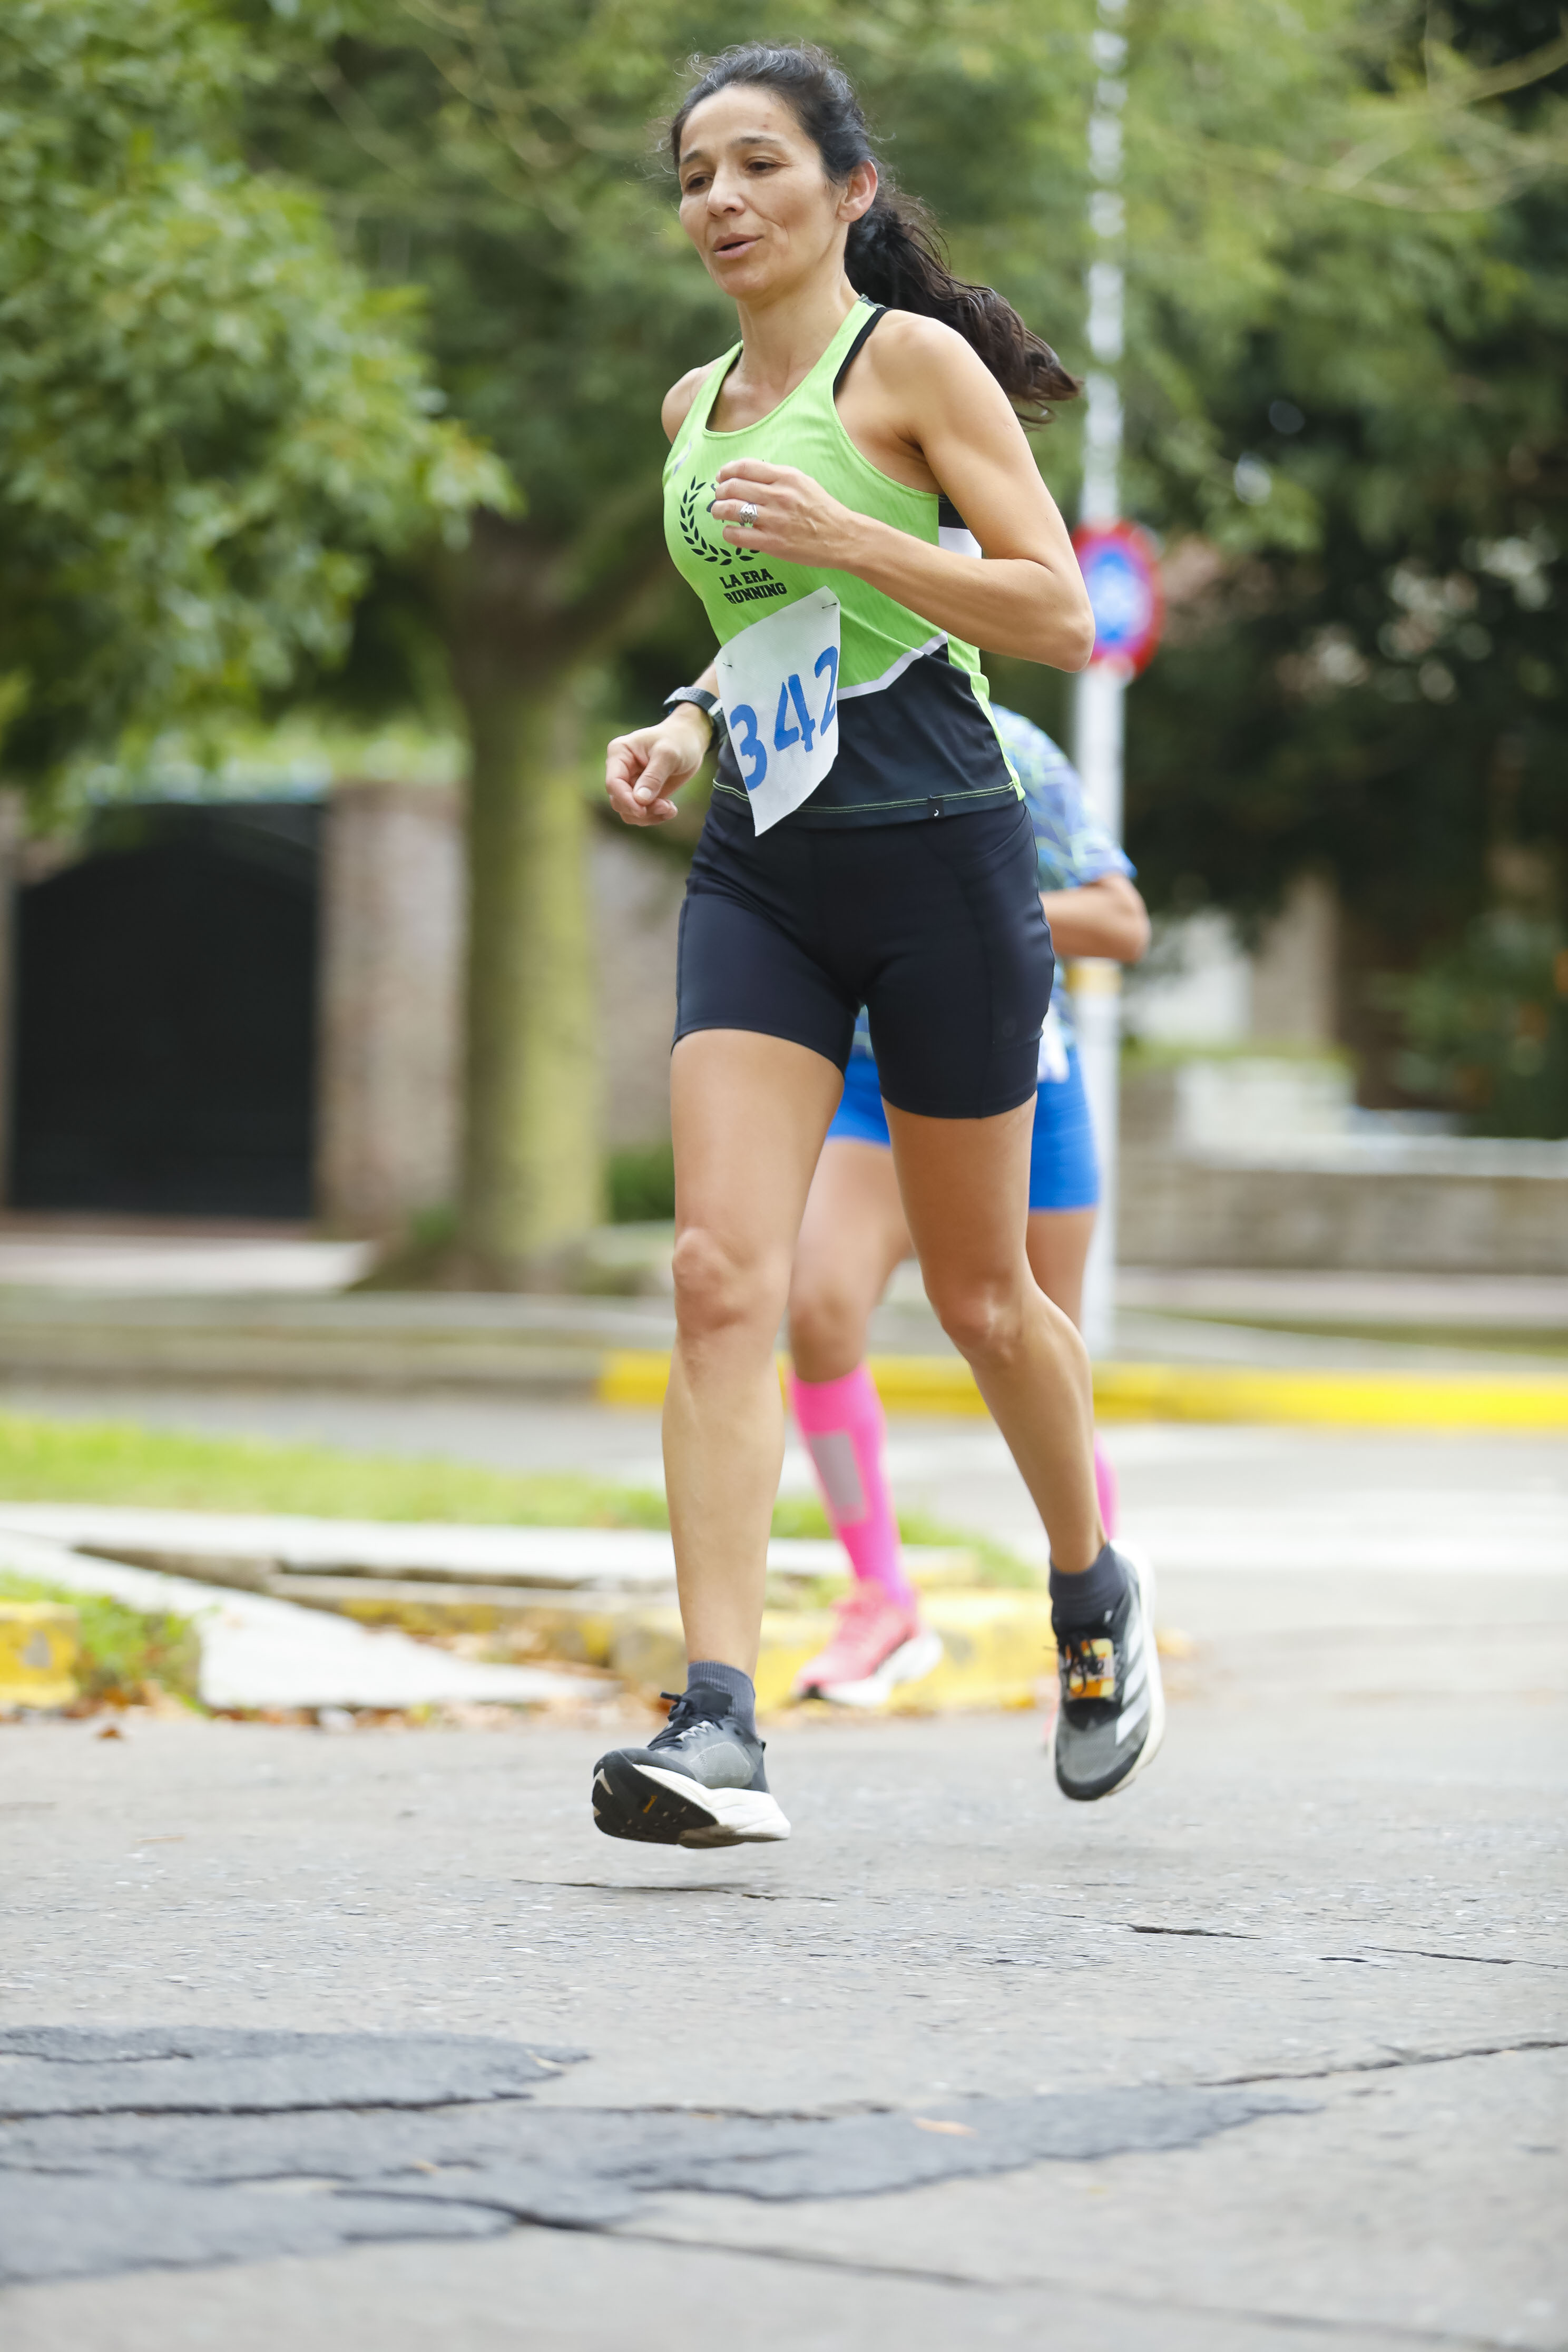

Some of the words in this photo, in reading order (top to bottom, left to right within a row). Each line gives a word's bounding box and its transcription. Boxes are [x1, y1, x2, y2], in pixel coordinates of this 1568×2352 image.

[719, 574, 742, 589] LA
[740, 569, 774, 584] ERA
[723, 582, 787, 604] RUNNING
[730, 646, 838, 791] 342
